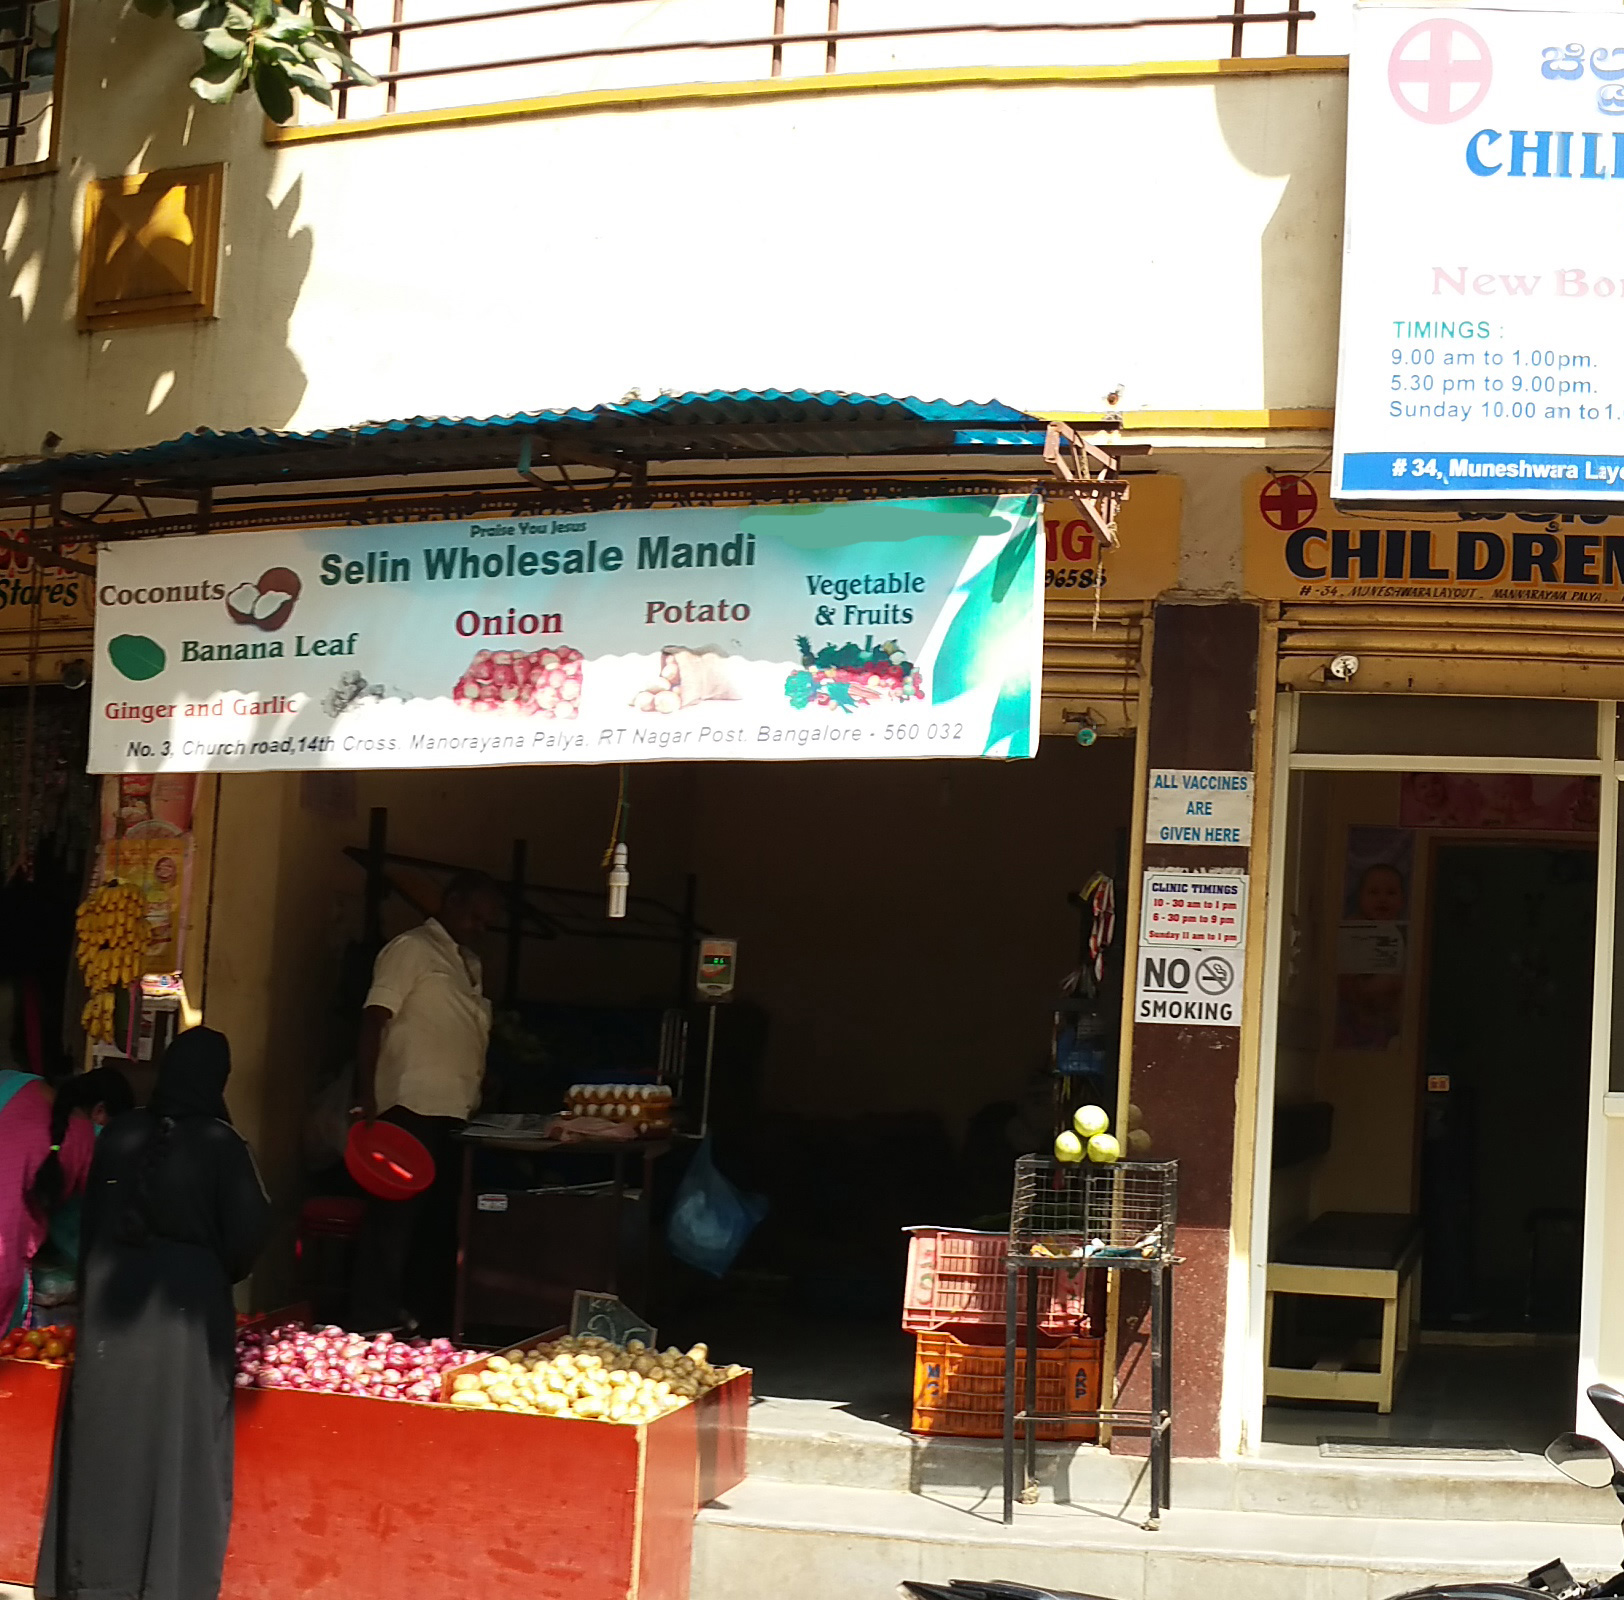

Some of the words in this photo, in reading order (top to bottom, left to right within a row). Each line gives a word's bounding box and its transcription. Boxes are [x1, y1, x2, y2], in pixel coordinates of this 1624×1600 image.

[1432, 266, 1542, 296] New
[1393, 320, 1491, 340] TIMINGS
[1391, 348, 1435, 366] 9.00
[1442, 352, 1476, 367] am
[1483, 350, 1503, 367] to
[1391, 374, 1434, 392] 5.30
[1442, 378, 1476, 397] pm
[1484, 375, 1504, 392] to
[1390, 400, 1472, 422] Sunday
[1481, 401, 1537, 419] 10.00
[1579, 403, 1600, 420] to
[1448, 459, 1580, 480] Muneshwara
[469, 522, 515, 539] Praise
[518, 520, 547, 536] You
[549, 518, 588, 535] Jesus
[319, 551, 410, 586] Selin
[424, 540, 624, 583] Wholesale
[637, 533, 756, 571] Mandi
[99, 579, 226, 607] Coconuts
[805, 571, 926, 601] Vegetable
[455, 608, 564, 639] Onion
[645, 599, 751, 625] Potato
[815, 604, 835, 626] &
[843, 603, 914, 627] Fruits
[180, 637, 284, 664] Banana
[295, 632, 360, 659] Leaf
[104, 699, 177, 726] Ginger
[184, 698, 223, 718] and
[233, 694, 300, 719] Garlic
[126, 741, 157, 759] No.
[182, 738, 246, 758] Church
[598, 728, 629, 748] RT
[633, 727, 692, 750] Nagar
[757, 724, 862, 747] Bangalore
[884, 724, 920, 741] 560
[926, 723, 963, 740] 032
[1154, 774, 1179, 790] ALL
[1182, 775, 1248, 792] VACCINES
[1185, 800, 1212, 816] ARE
[1160, 825, 1202, 842] GIVEN
[1204, 826, 1240, 843] HERE
[1152, 882, 1189, 894] CLINIC
[1191, 883, 1238, 895] TIMINGS
[1144, 957, 1190, 989] NO
[1140, 1000, 1233, 1022] SMOKING
